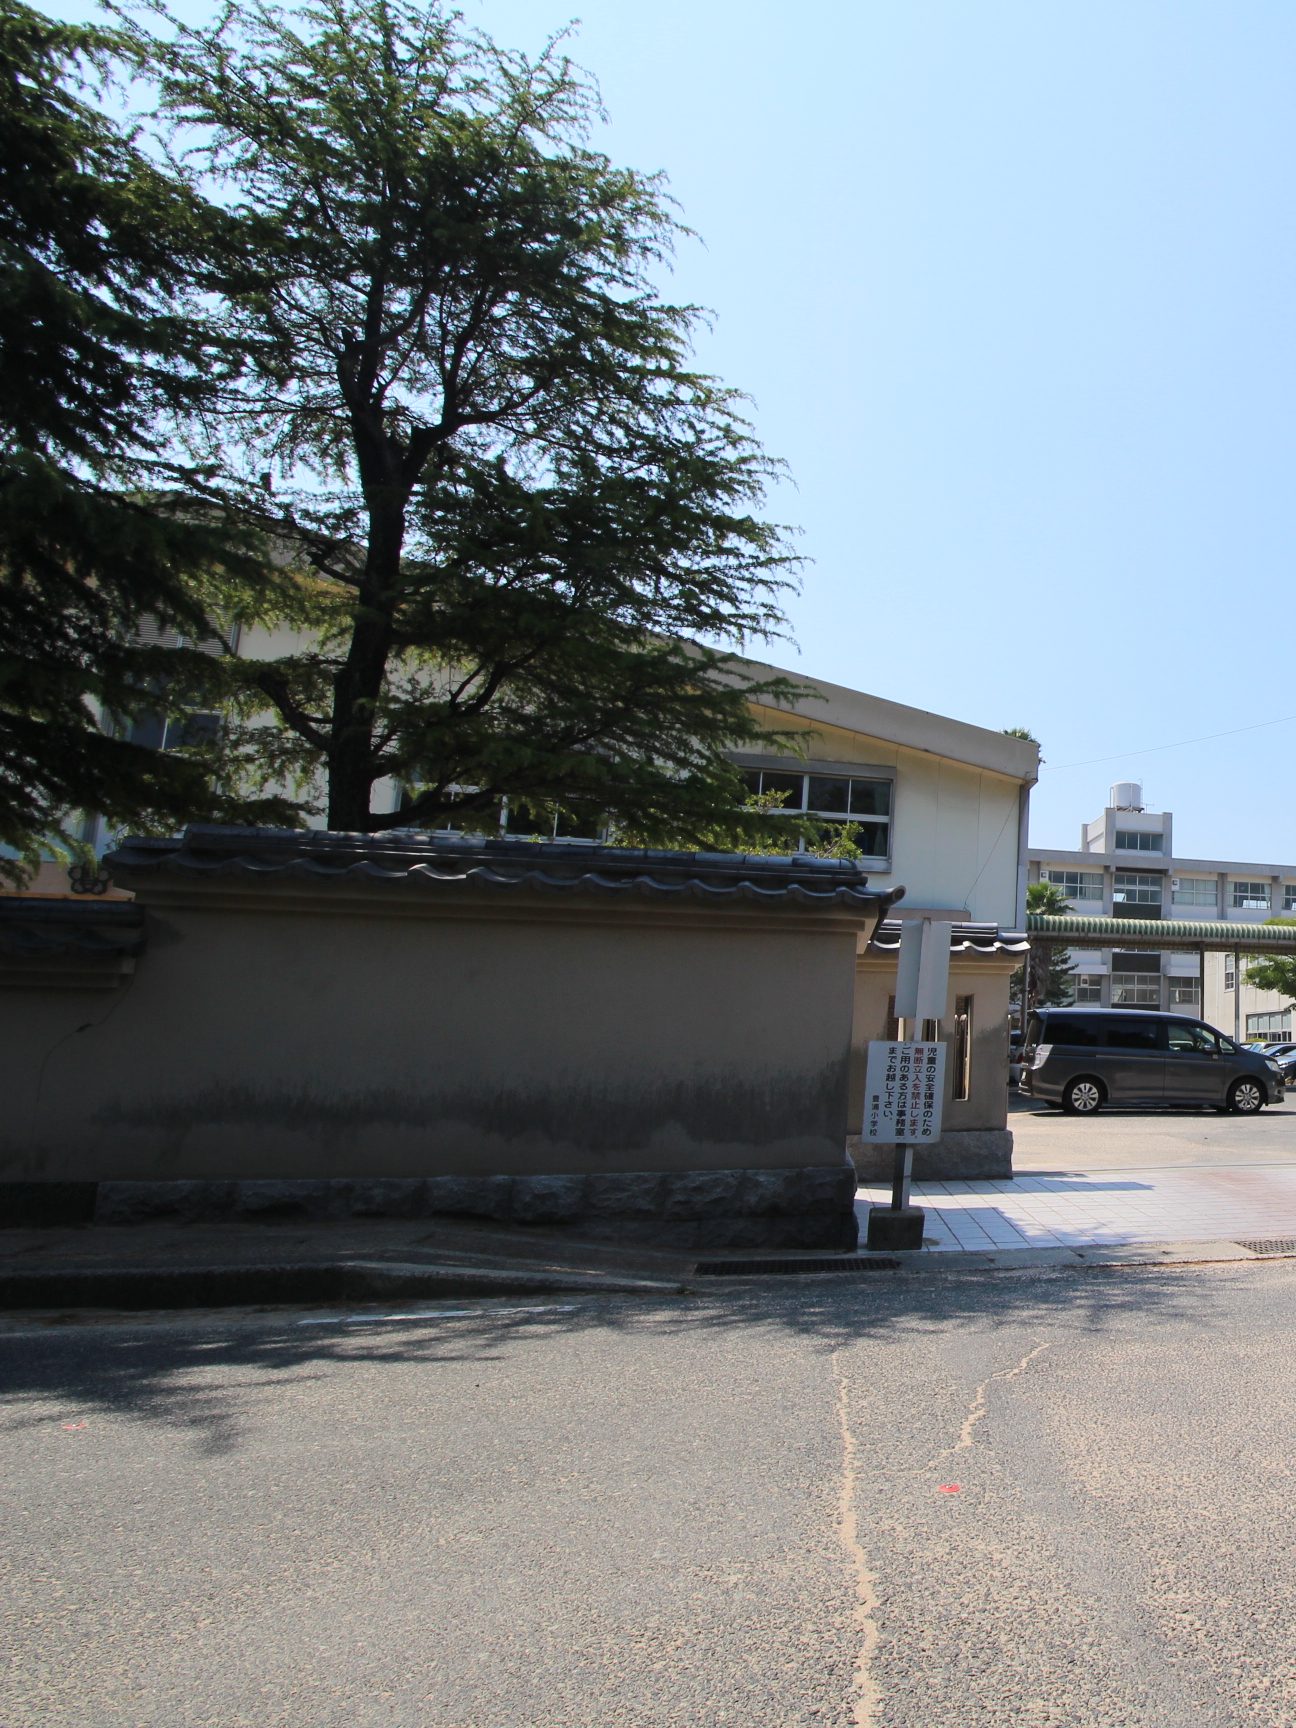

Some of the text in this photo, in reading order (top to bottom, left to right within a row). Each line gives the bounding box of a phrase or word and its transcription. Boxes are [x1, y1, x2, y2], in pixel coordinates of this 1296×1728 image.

[883, 1046, 898, 1120] までお越し下さい。
[895, 1046, 911, 1136] ご用のある方は事務室
[908, 1047, 924, 1139] 無断立入を禁止します。
[921, 1047, 937, 1136] 児童の安全確保のため
